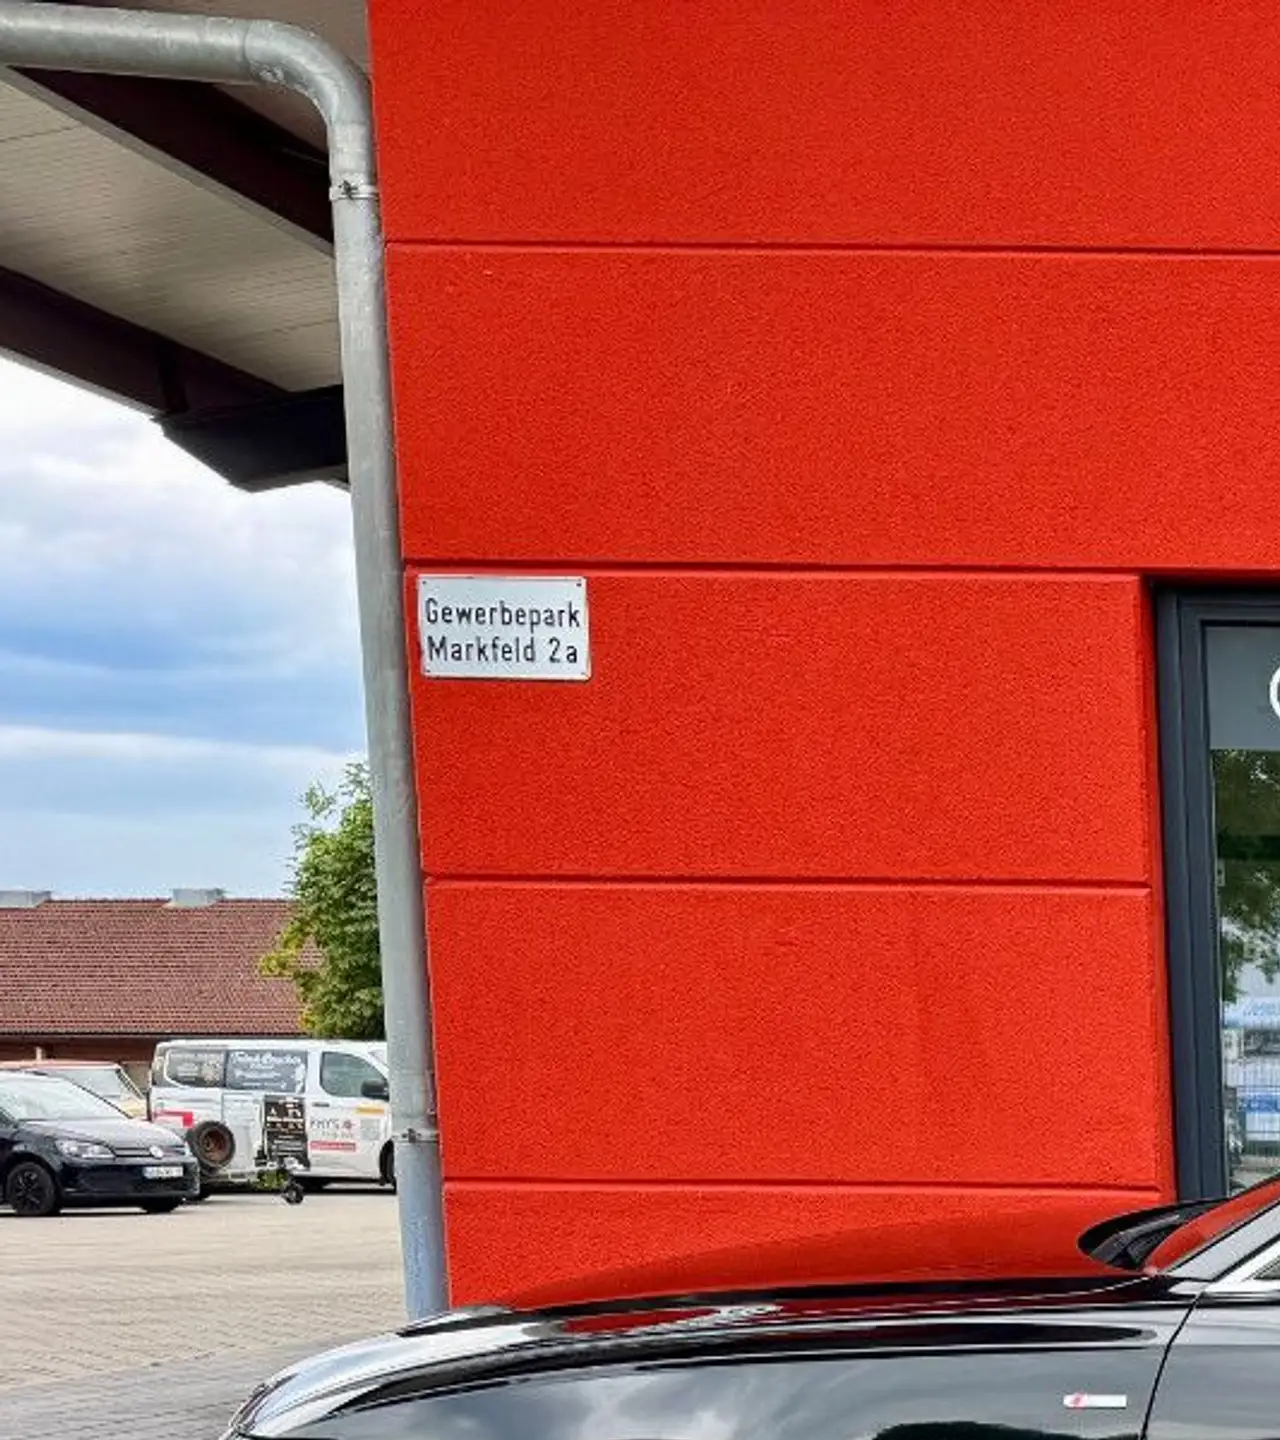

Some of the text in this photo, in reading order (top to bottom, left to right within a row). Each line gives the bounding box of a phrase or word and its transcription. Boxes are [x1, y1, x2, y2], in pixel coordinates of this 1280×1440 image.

[425, 597, 580, 633] Gewerbepark
[427, 635, 578, 663] Markfeld 2a
